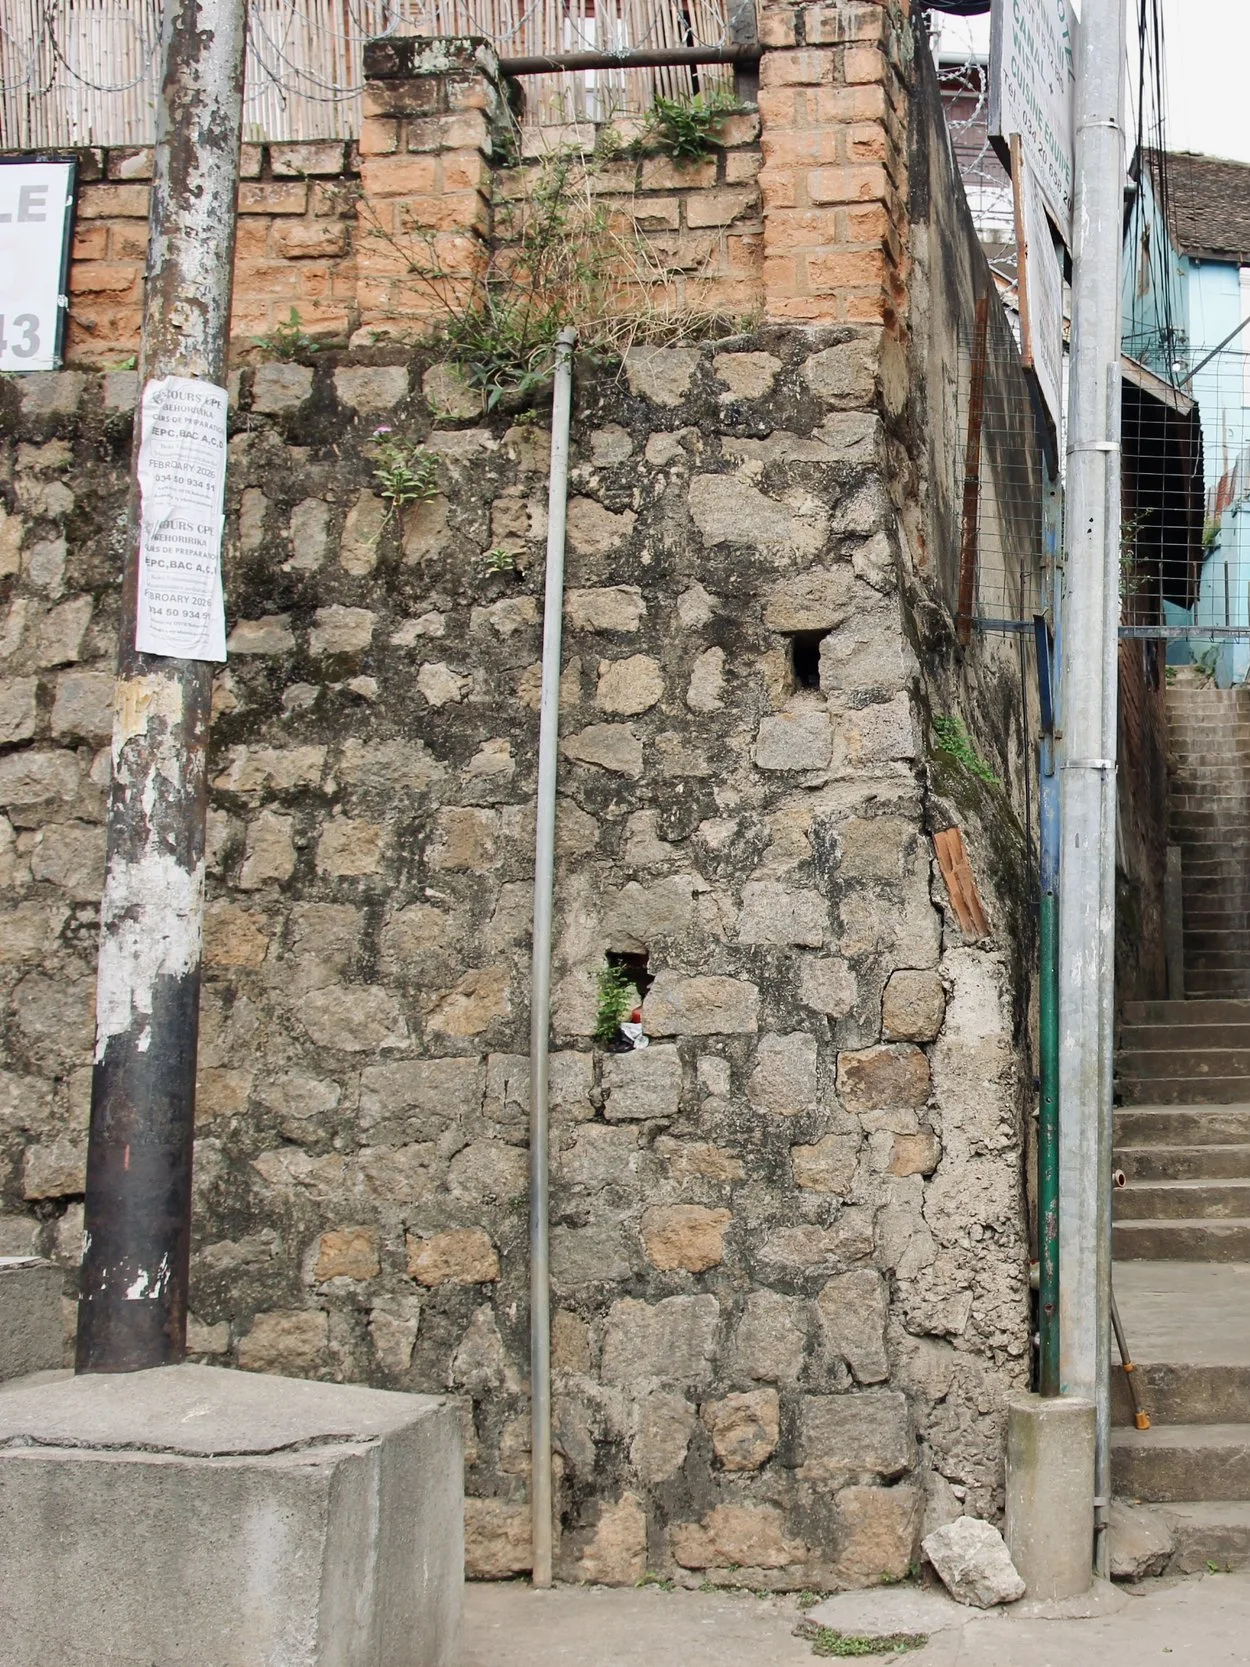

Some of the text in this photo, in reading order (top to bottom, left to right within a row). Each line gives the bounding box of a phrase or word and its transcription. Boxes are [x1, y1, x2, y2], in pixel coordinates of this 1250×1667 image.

[1012, 23, 1035, 85] WIFI
[1013, 0, 1046, 85] CANAL
[1011, 56, 1043, 132] CUISINE
[0, 313, 41, 359] 3
[182, 610, 200, 619] 934
